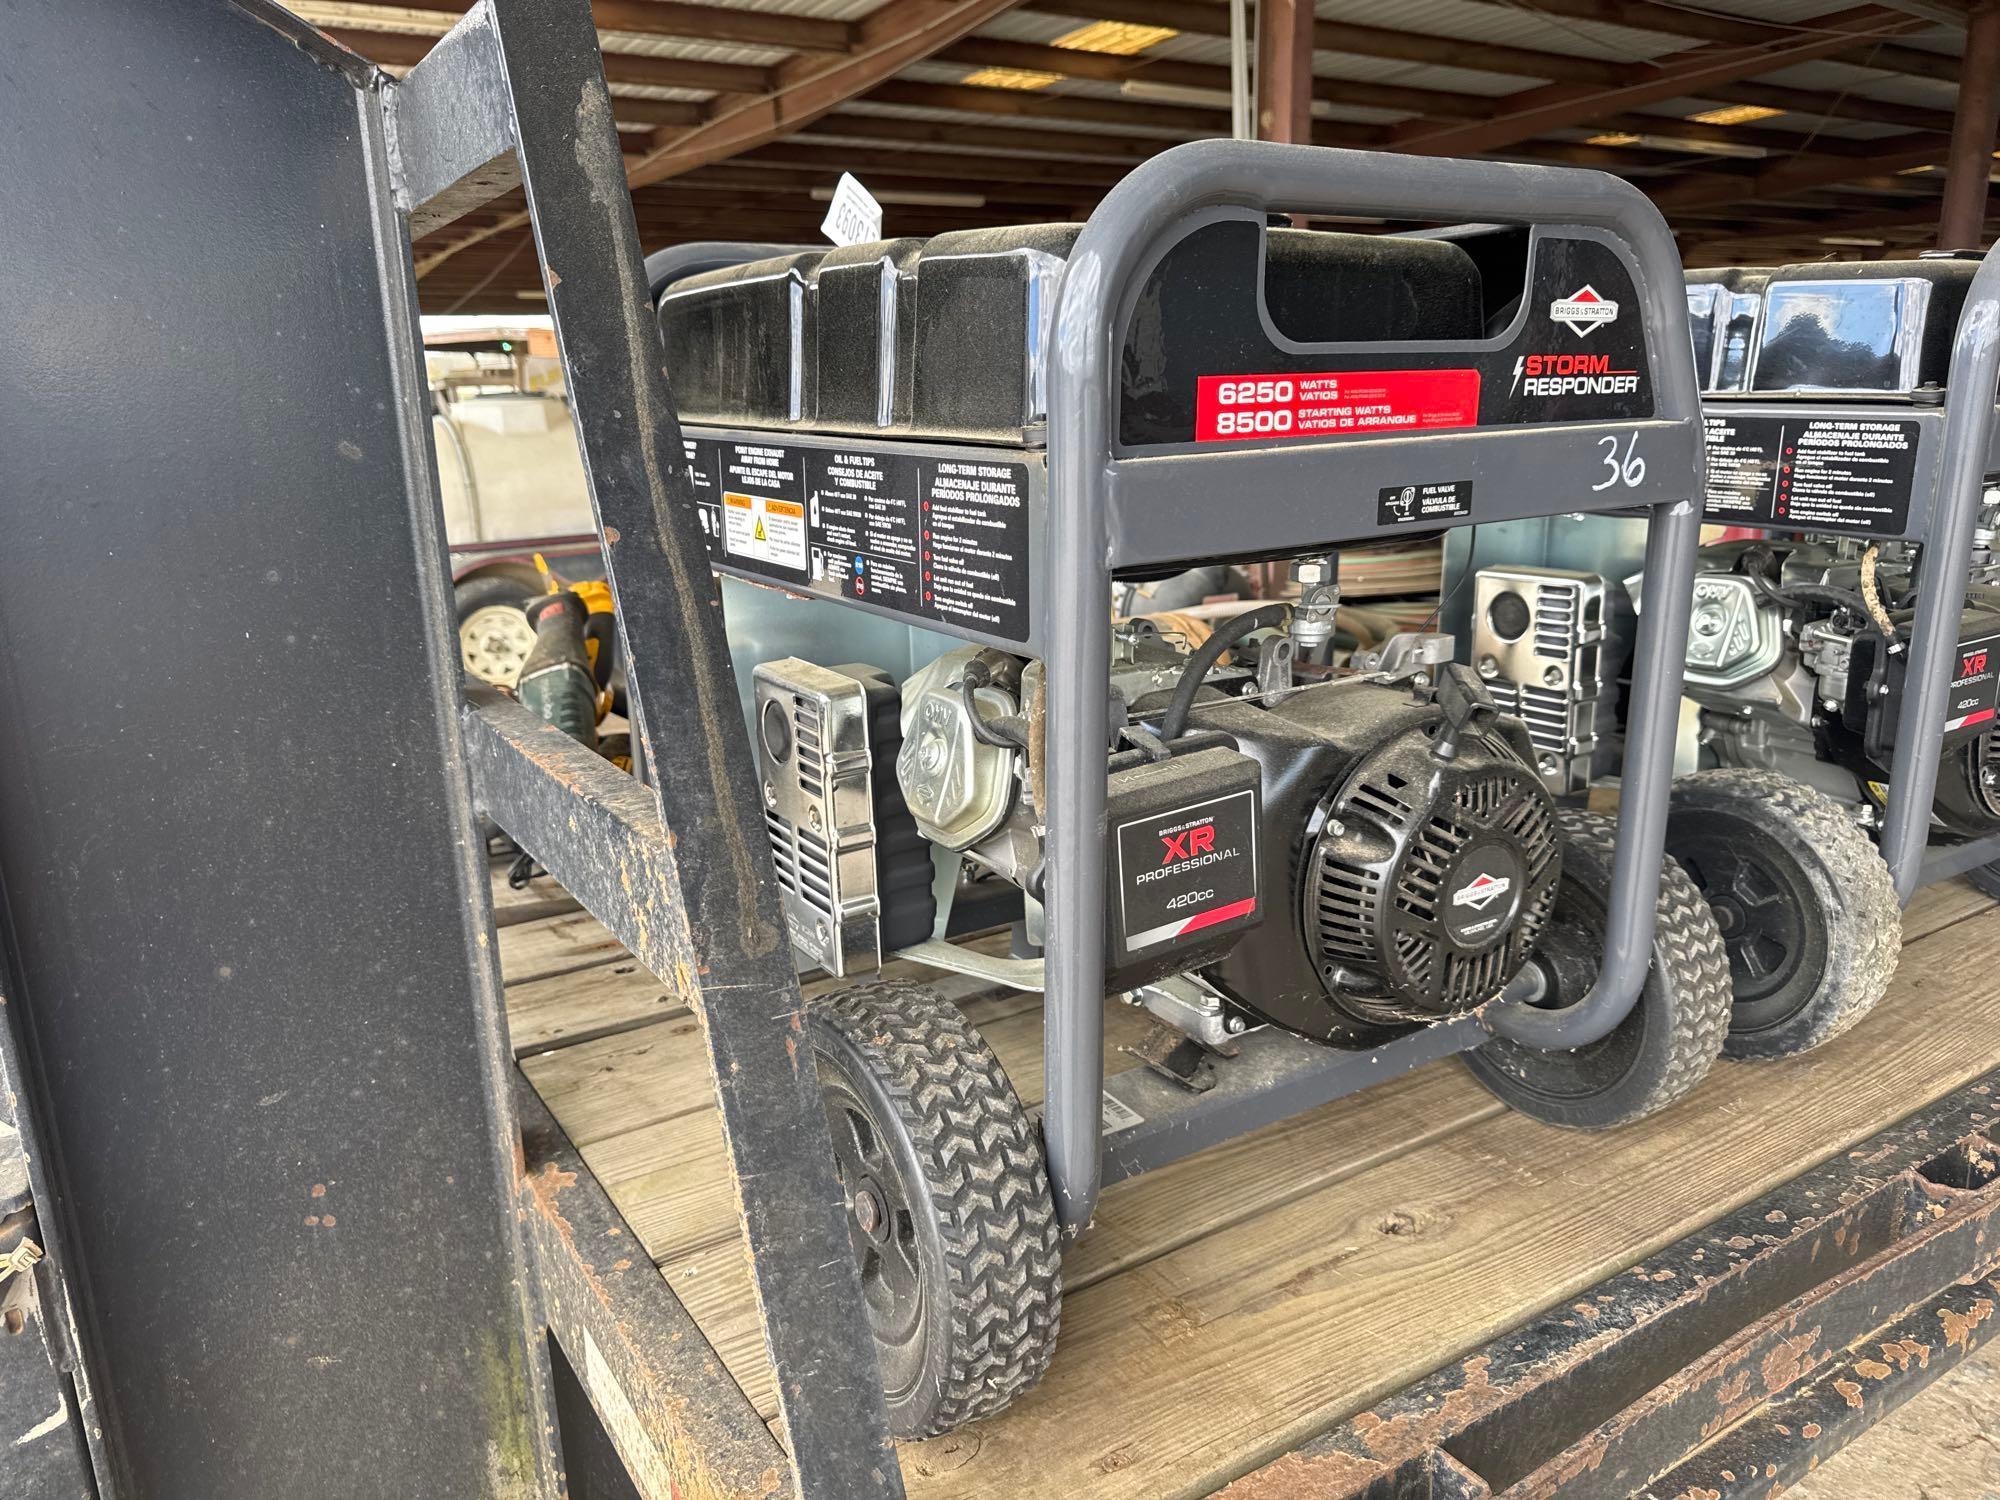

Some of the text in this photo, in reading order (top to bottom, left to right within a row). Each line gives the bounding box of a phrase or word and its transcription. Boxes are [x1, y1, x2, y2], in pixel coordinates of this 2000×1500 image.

[1526, 355, 1610, 375] STORM
[1300, 380, 1337, 389] WATTS
[1523, 376, 1638, 396] RESPONDER
[1217, 380, 1293, 405] 6250
[1299, 391, 1338, 401] VATIOS
[1298, 405, 1391, 418] STARTING WATTS
[1216, 409, 1293, 434] 8500
[1298, 418, 1337, 429] VATIOS
[1340, 417, 1354, 427] DE
[1709, 419, 1726, 427] TIPS
[1809, 422, 1901, 431] LONG-TERM STORAGE
[1709, 428, 1736, 436] ACEITE
[1803, 431, 1905, 441] ALMACENAJE DURANTE
[1842, 440, 1908, 449] PROLONGADOS
[834, 454, 875, 467] OIL & FUEL TIPS
[1592, 430, 1646, 491] 36
[827, 466, 883, 481] CONSEJOS DE ACEITE
[938, 463, 1011, 479] LONG-TERM STORAGE
[834, 477, 876, 490] Y COMBUSTIBLE
[935, 477, 1016, 495] ALMACENAJE DURANTE
[1438, 485, 1455, 493] VALVE
[966, 492, 1020, 507] PROLONGADOS
[1421, 503, 1460, 513] COMBUSTIBLE
[1961, 654, 1987, 677] XR
[1957, 698, 1979, 709] 420cc
[1161, 825, 1215, 865] XR
[1136, 848, 1240, 885] PROFESSIONAL
[1166, 889, 1214, 909] 420cc
